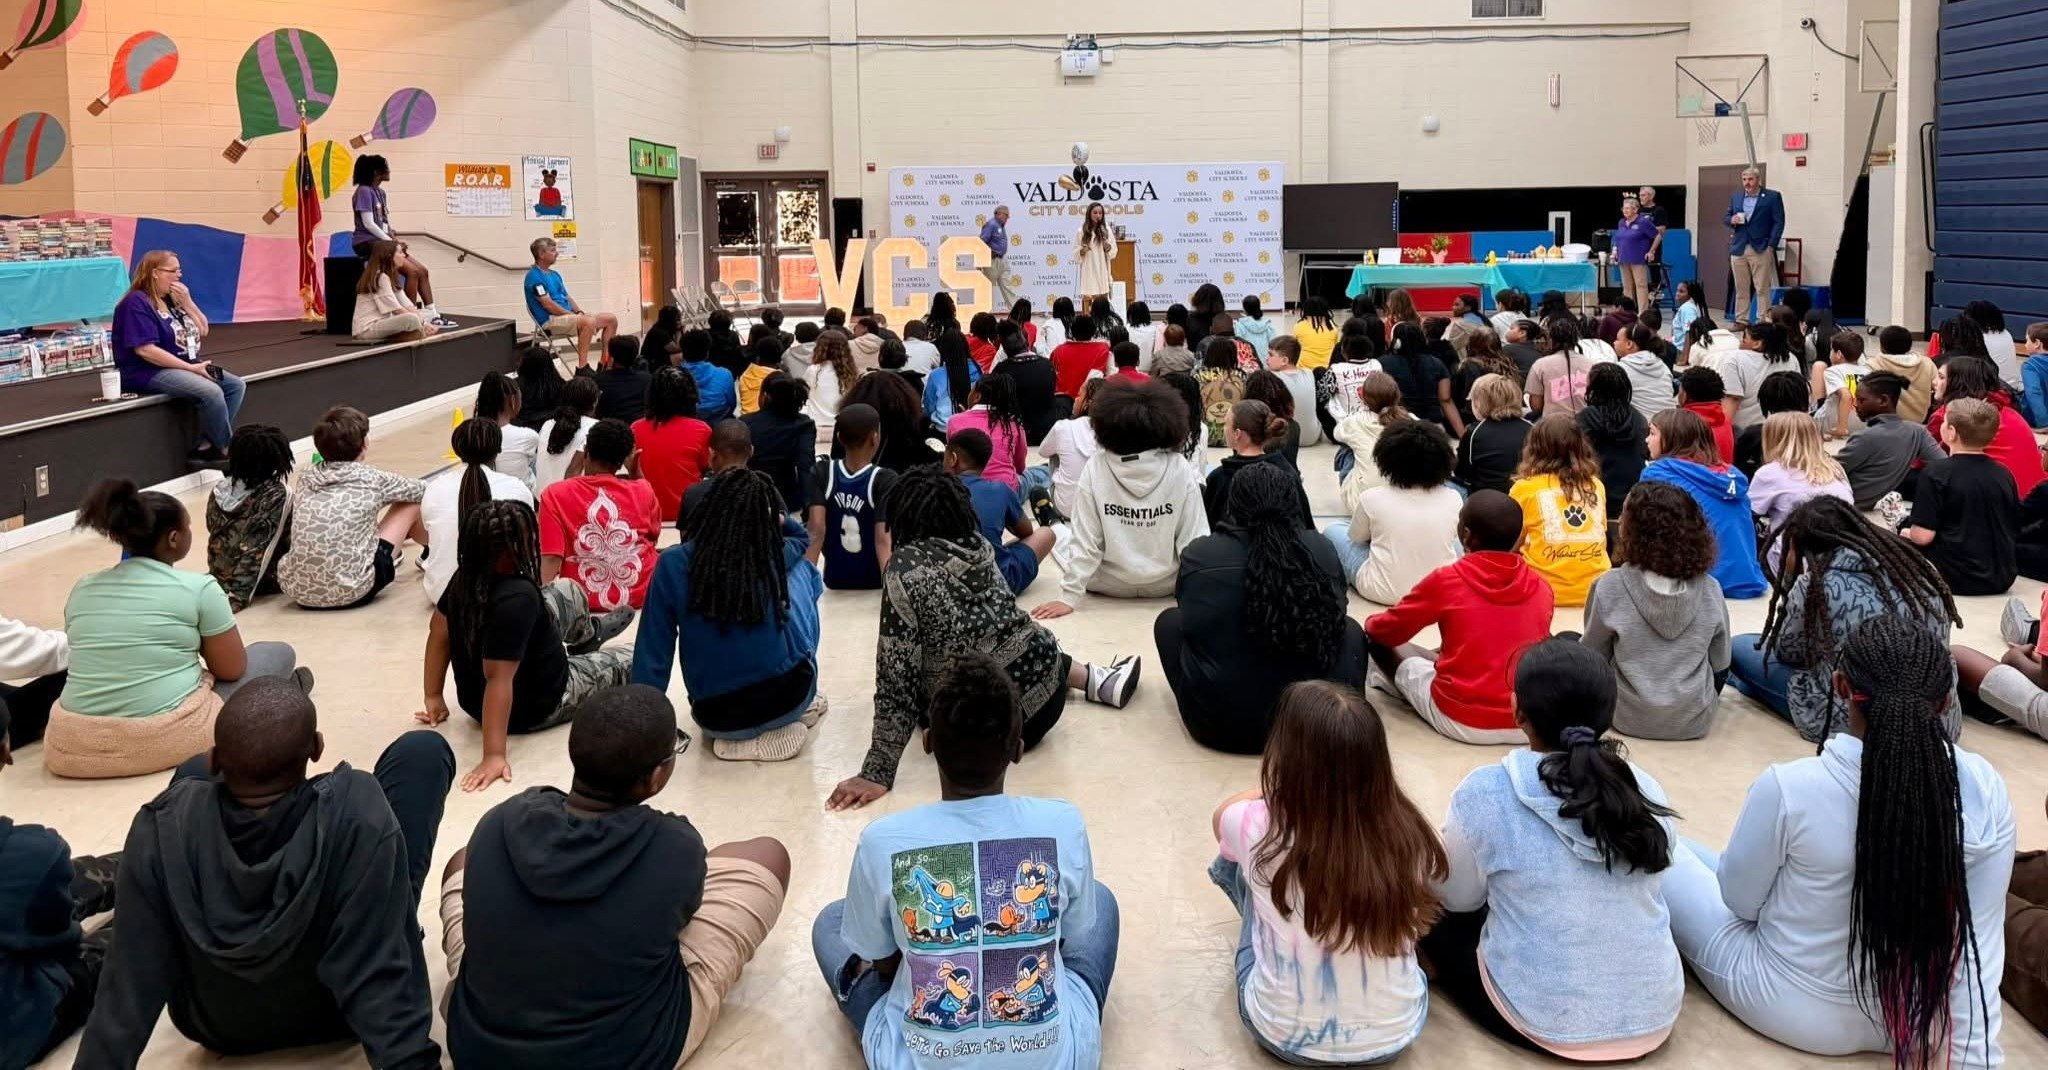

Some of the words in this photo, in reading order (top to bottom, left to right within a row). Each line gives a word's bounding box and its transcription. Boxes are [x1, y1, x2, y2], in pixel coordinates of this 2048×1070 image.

[453, 173, 505, 187] R.O.A.R.
[1028, 204, 1065, 216] CITY
[1068, 204, 1144, 216] SCOOLS
[1104, 503, 1173, 519] ESSENTIALS
[894, 854, 910, 869] And
[934, 1042, 950, 1059] Go
[984, 1038, 1005, 1054] the
